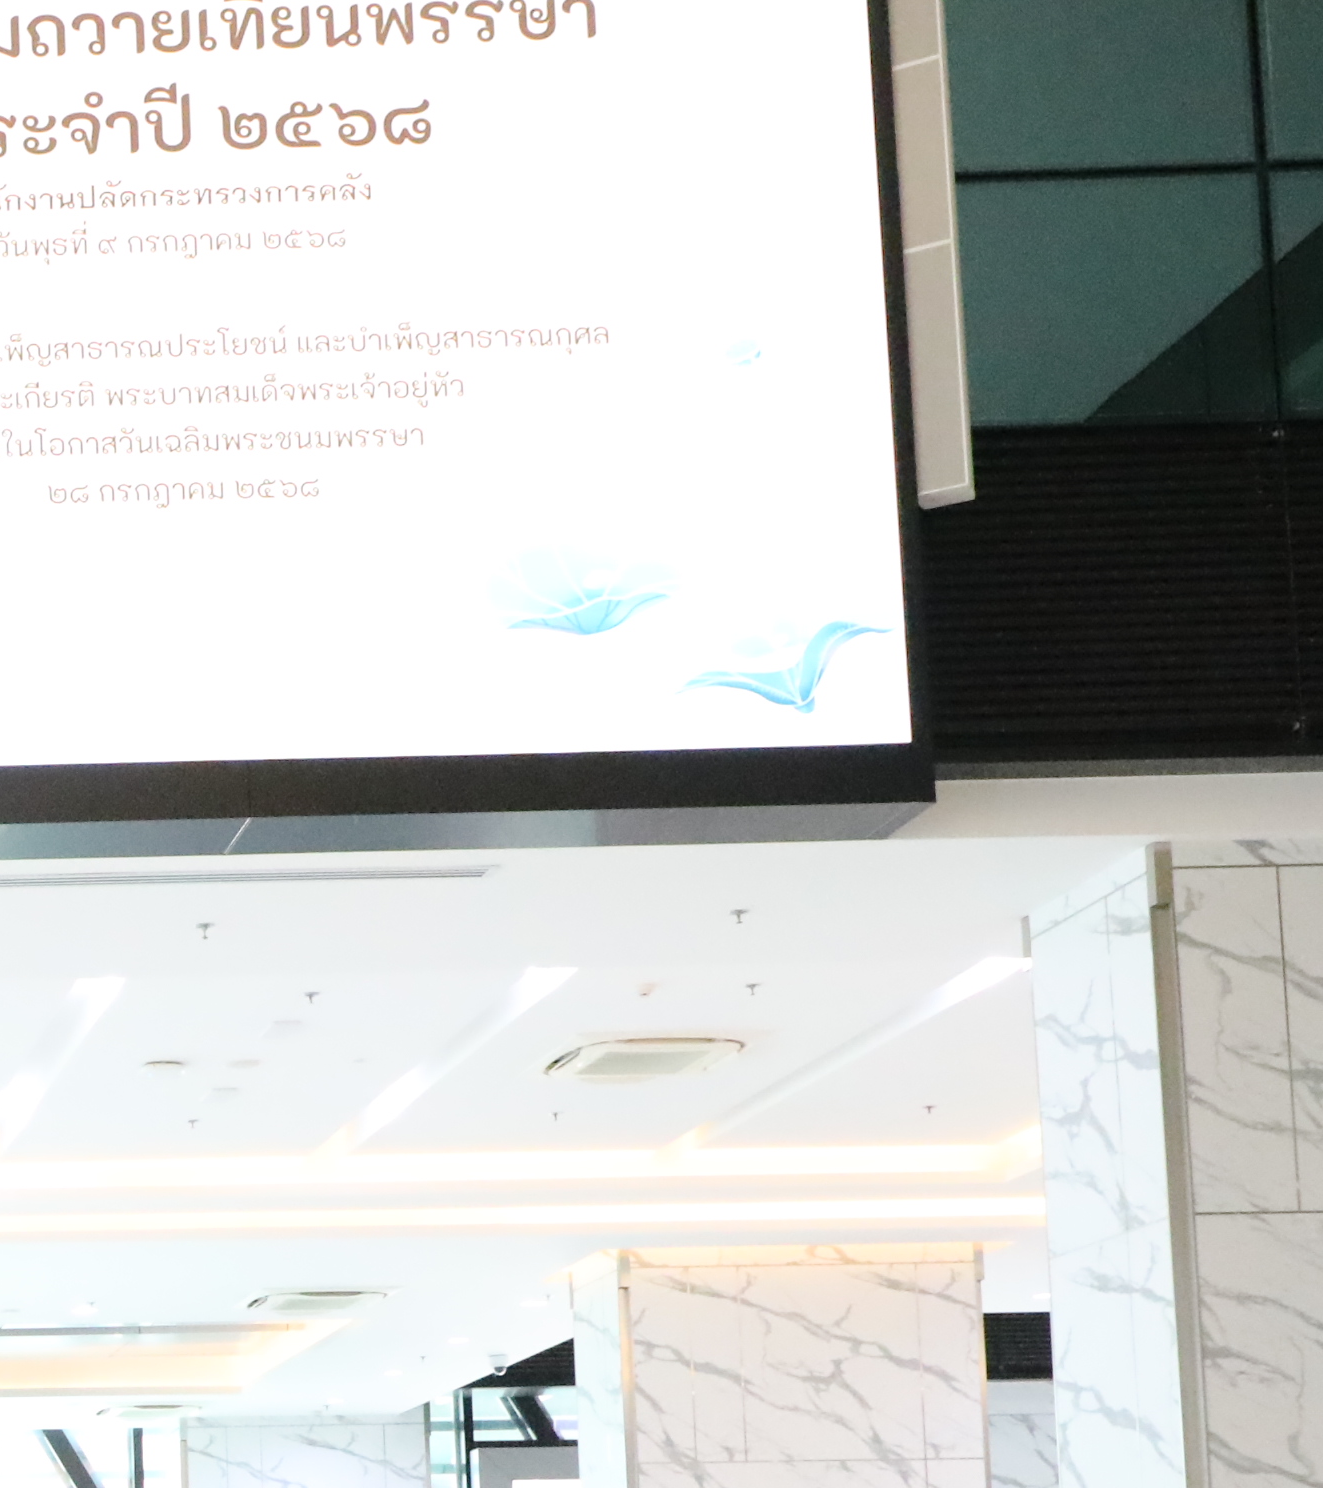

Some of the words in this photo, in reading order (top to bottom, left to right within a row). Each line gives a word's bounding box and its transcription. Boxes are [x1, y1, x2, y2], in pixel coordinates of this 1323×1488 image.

[217, 97, 433, 151] ๒๕๖๘
[97, 235, 119, 255] ๙
[127, 231, 253, 261] กรกฎาคม
[262, 227, 348, 251] ๒๕๖๘
[296, 320, 611, 358] และบำเพ็ญสาธารณกุศล
[104, 370, 466, 409] พระบาทสมเด็จพระเจ้าอยู่หัว
[47, 483, 90, 505] ๒๘
[98, 480, 224, 510] กรกฎาคม
[234, 477, 321, 500] ๒๕๖๘
